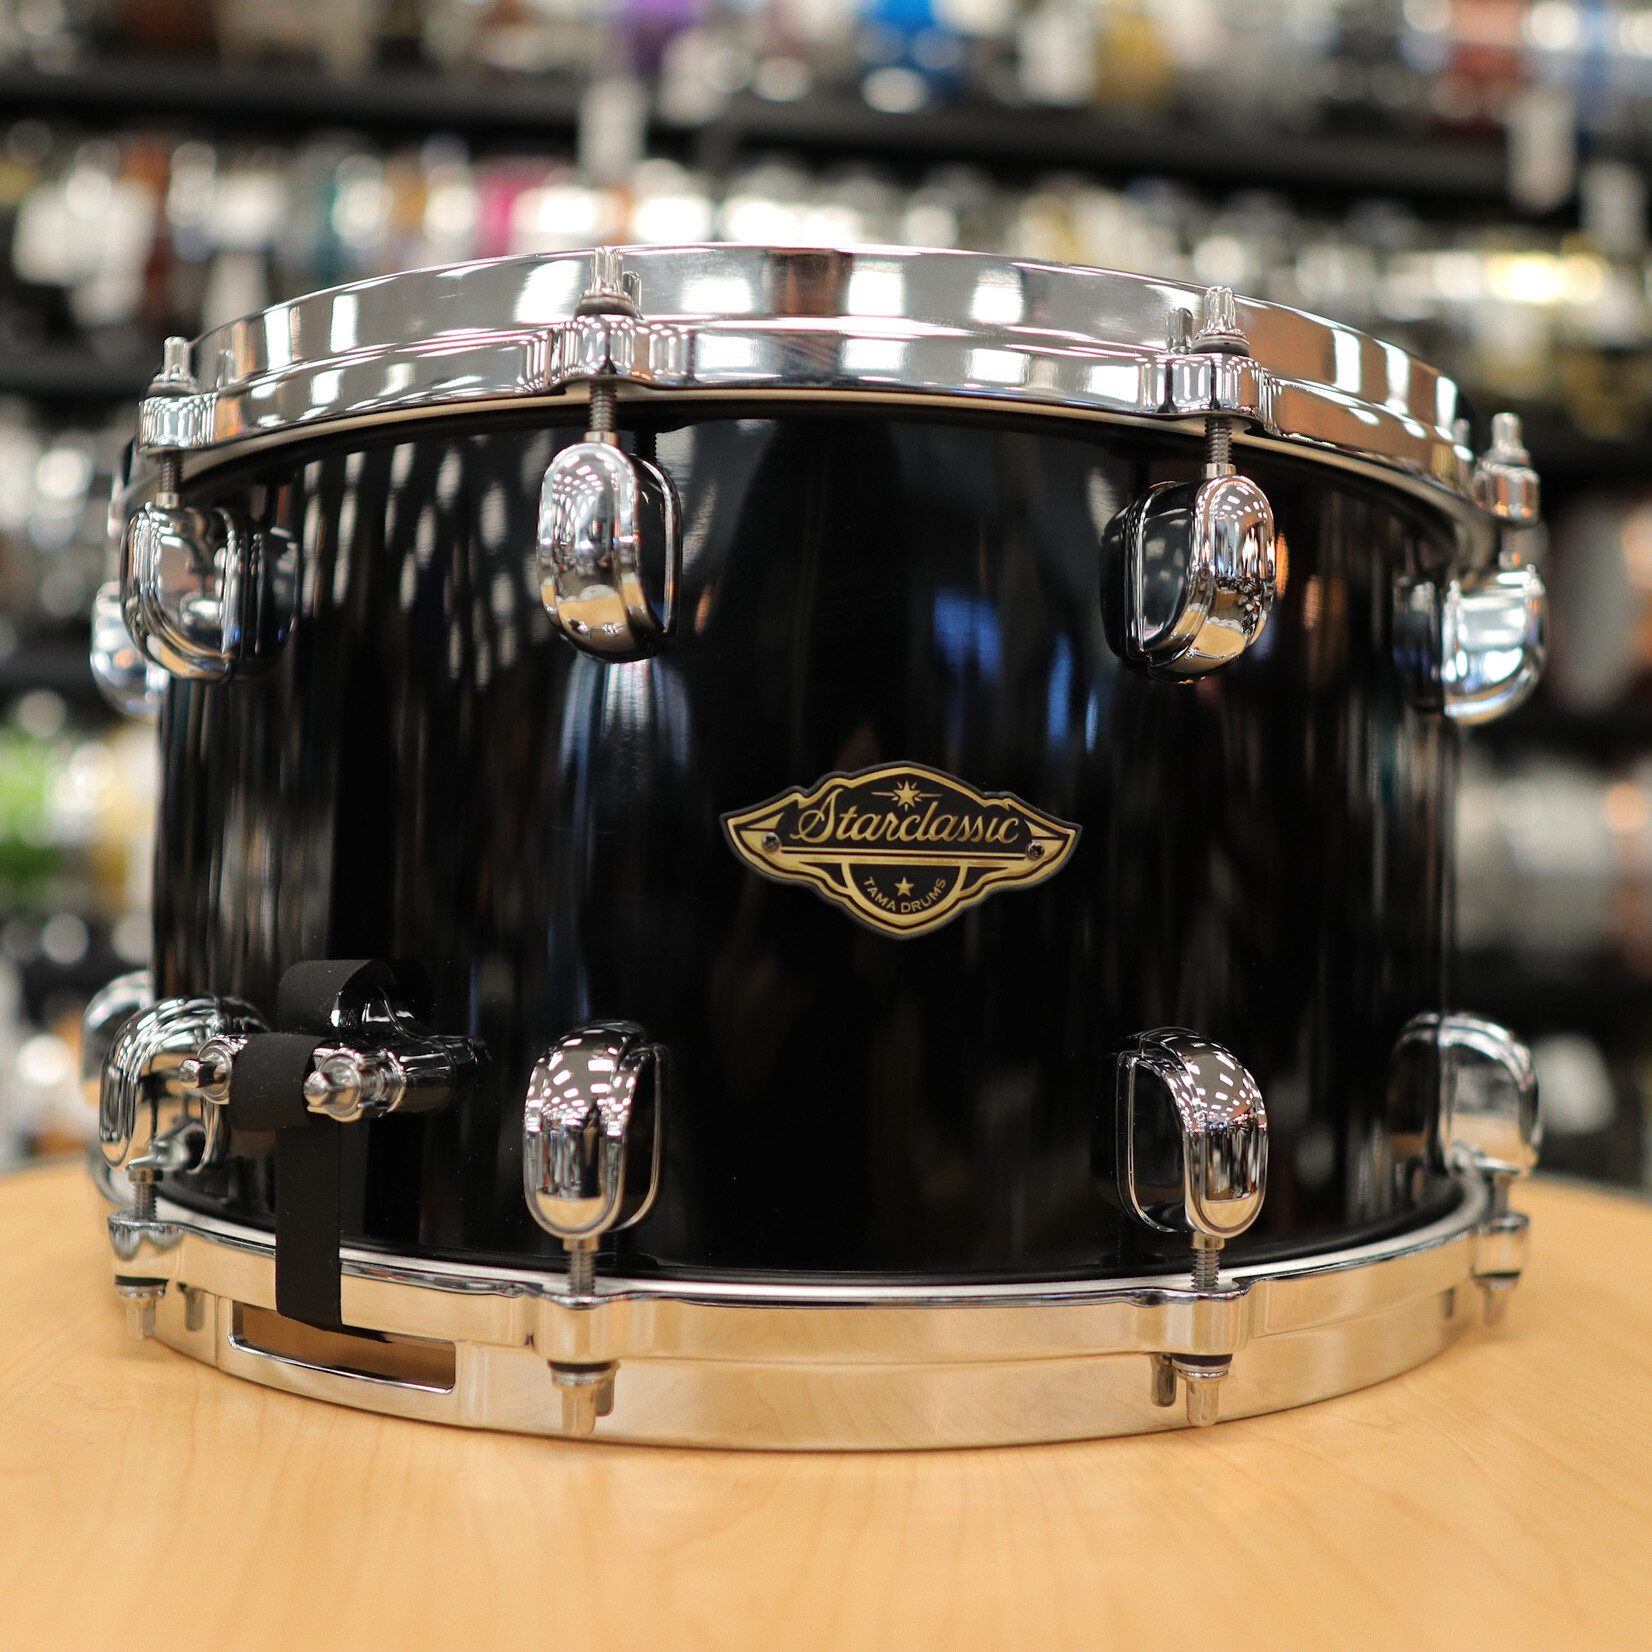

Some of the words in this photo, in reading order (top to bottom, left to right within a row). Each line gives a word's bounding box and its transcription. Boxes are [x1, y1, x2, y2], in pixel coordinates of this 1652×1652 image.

[789, 788, 1020, 844] Starclassic
[863, 876, 896, 912] TAMA
[901, 877, 947, 913] DRUMS
